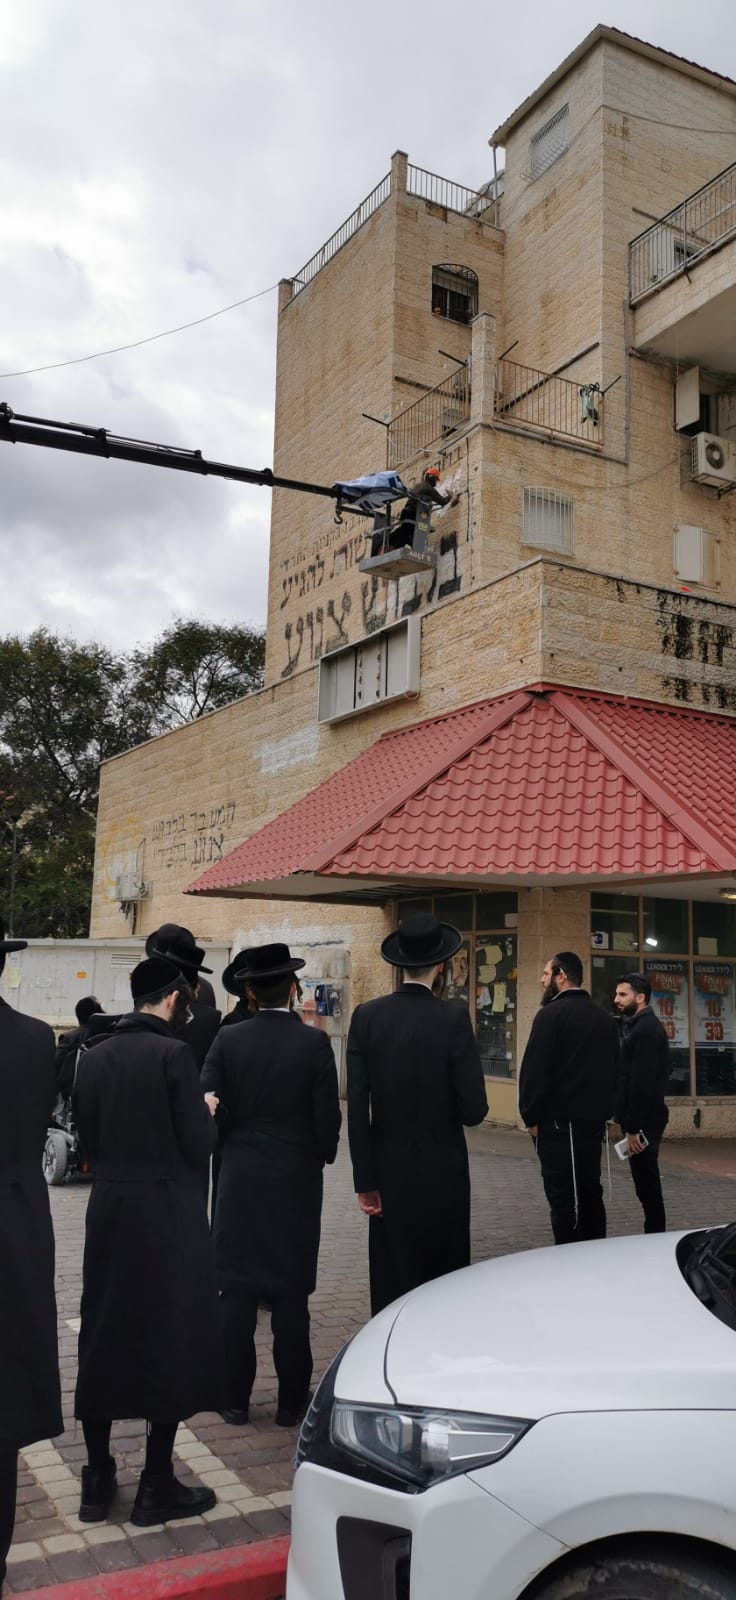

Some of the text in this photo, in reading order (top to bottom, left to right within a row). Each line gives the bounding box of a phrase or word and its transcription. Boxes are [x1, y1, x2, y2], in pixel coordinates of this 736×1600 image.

[281, 591, 352, 678] צנוע
[656, 973, 675, 985] FINAL
[703, 975, 722, 985] FINAL
[657, 998, 674, 1016] 10
[705, 999, 721, 1017] 10
